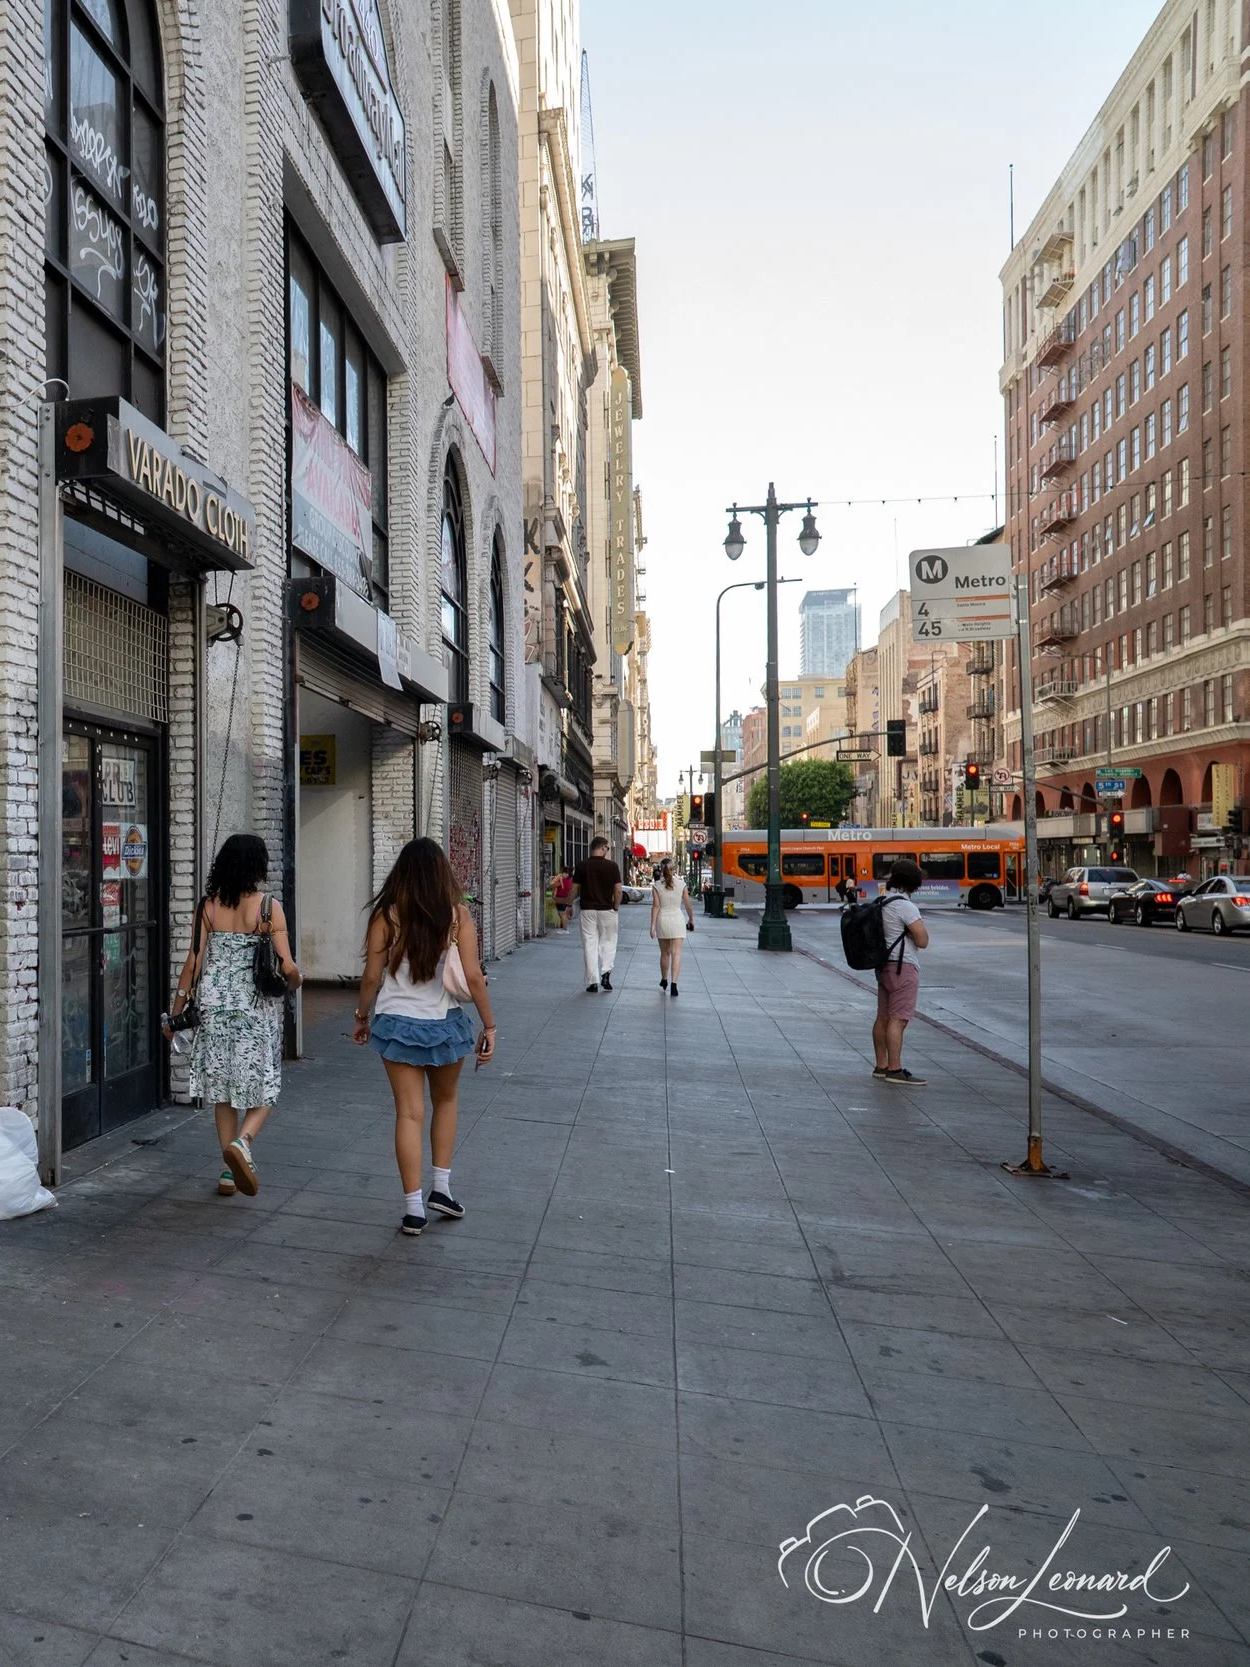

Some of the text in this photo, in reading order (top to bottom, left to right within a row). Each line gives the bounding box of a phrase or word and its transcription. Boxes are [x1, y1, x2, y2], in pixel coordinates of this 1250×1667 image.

[614, 391, 624, 503] JEWELRY
[127, 428, 249, 558] VARADO CLOTH
[616, 519, 625, 615] TRADES
[955, 574, 1006, 589] Metro
[918, 602, 930, 617] 4
[918, 620, 942, 637] 45
[856, 752, 870, 760] WAY
[102, 779, 135, 803] CLUB
[828, 830, 872, 841] Metro
[124, 845, 145, 857] Dickies
